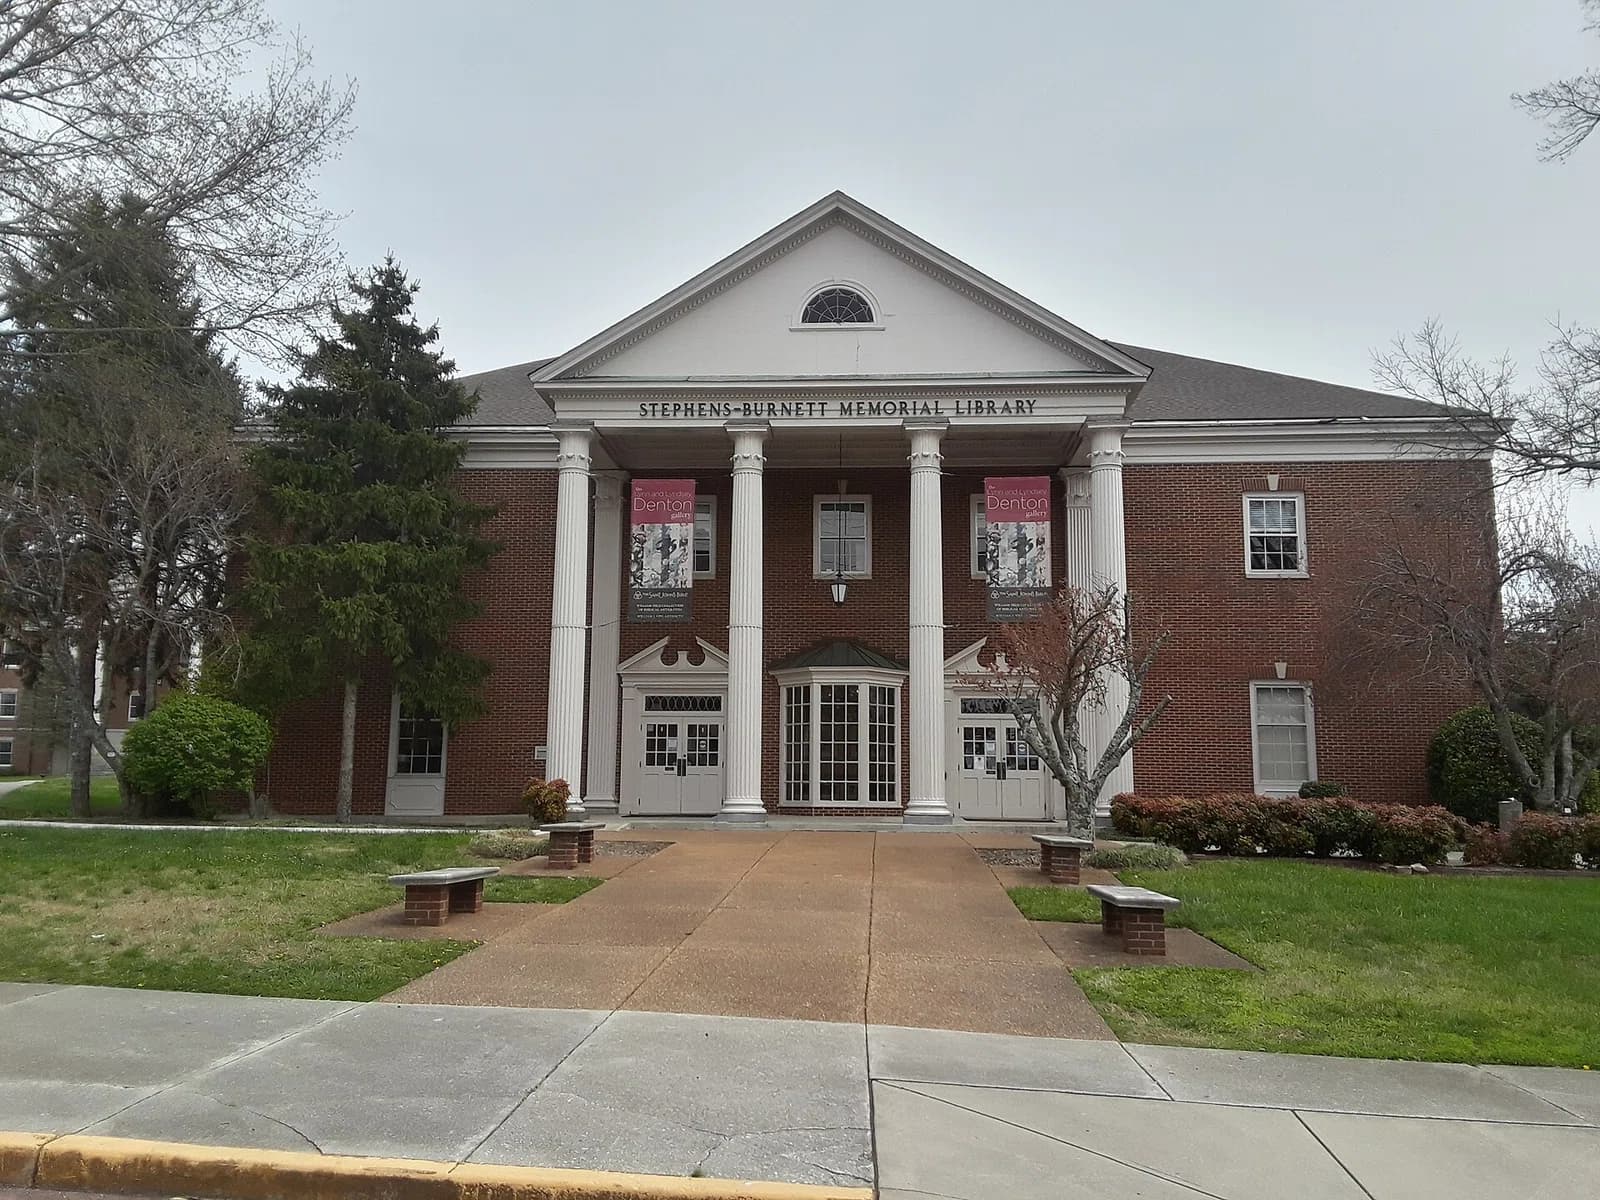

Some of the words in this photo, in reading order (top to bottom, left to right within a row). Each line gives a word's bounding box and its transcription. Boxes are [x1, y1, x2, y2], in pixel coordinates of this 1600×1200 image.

[639, 402, 828, 417] STEPHENS-BURNETT
[840, 401, 944, 416] MEMORIAL
[956, 399, 1037, 415] LIBRARY
[633, 497, 693, 512] Denton
[987, 495, 1048, 510] Denton
[670, 511, 691, 520] gallery
[1025, 510, 1047, 518] gallery
